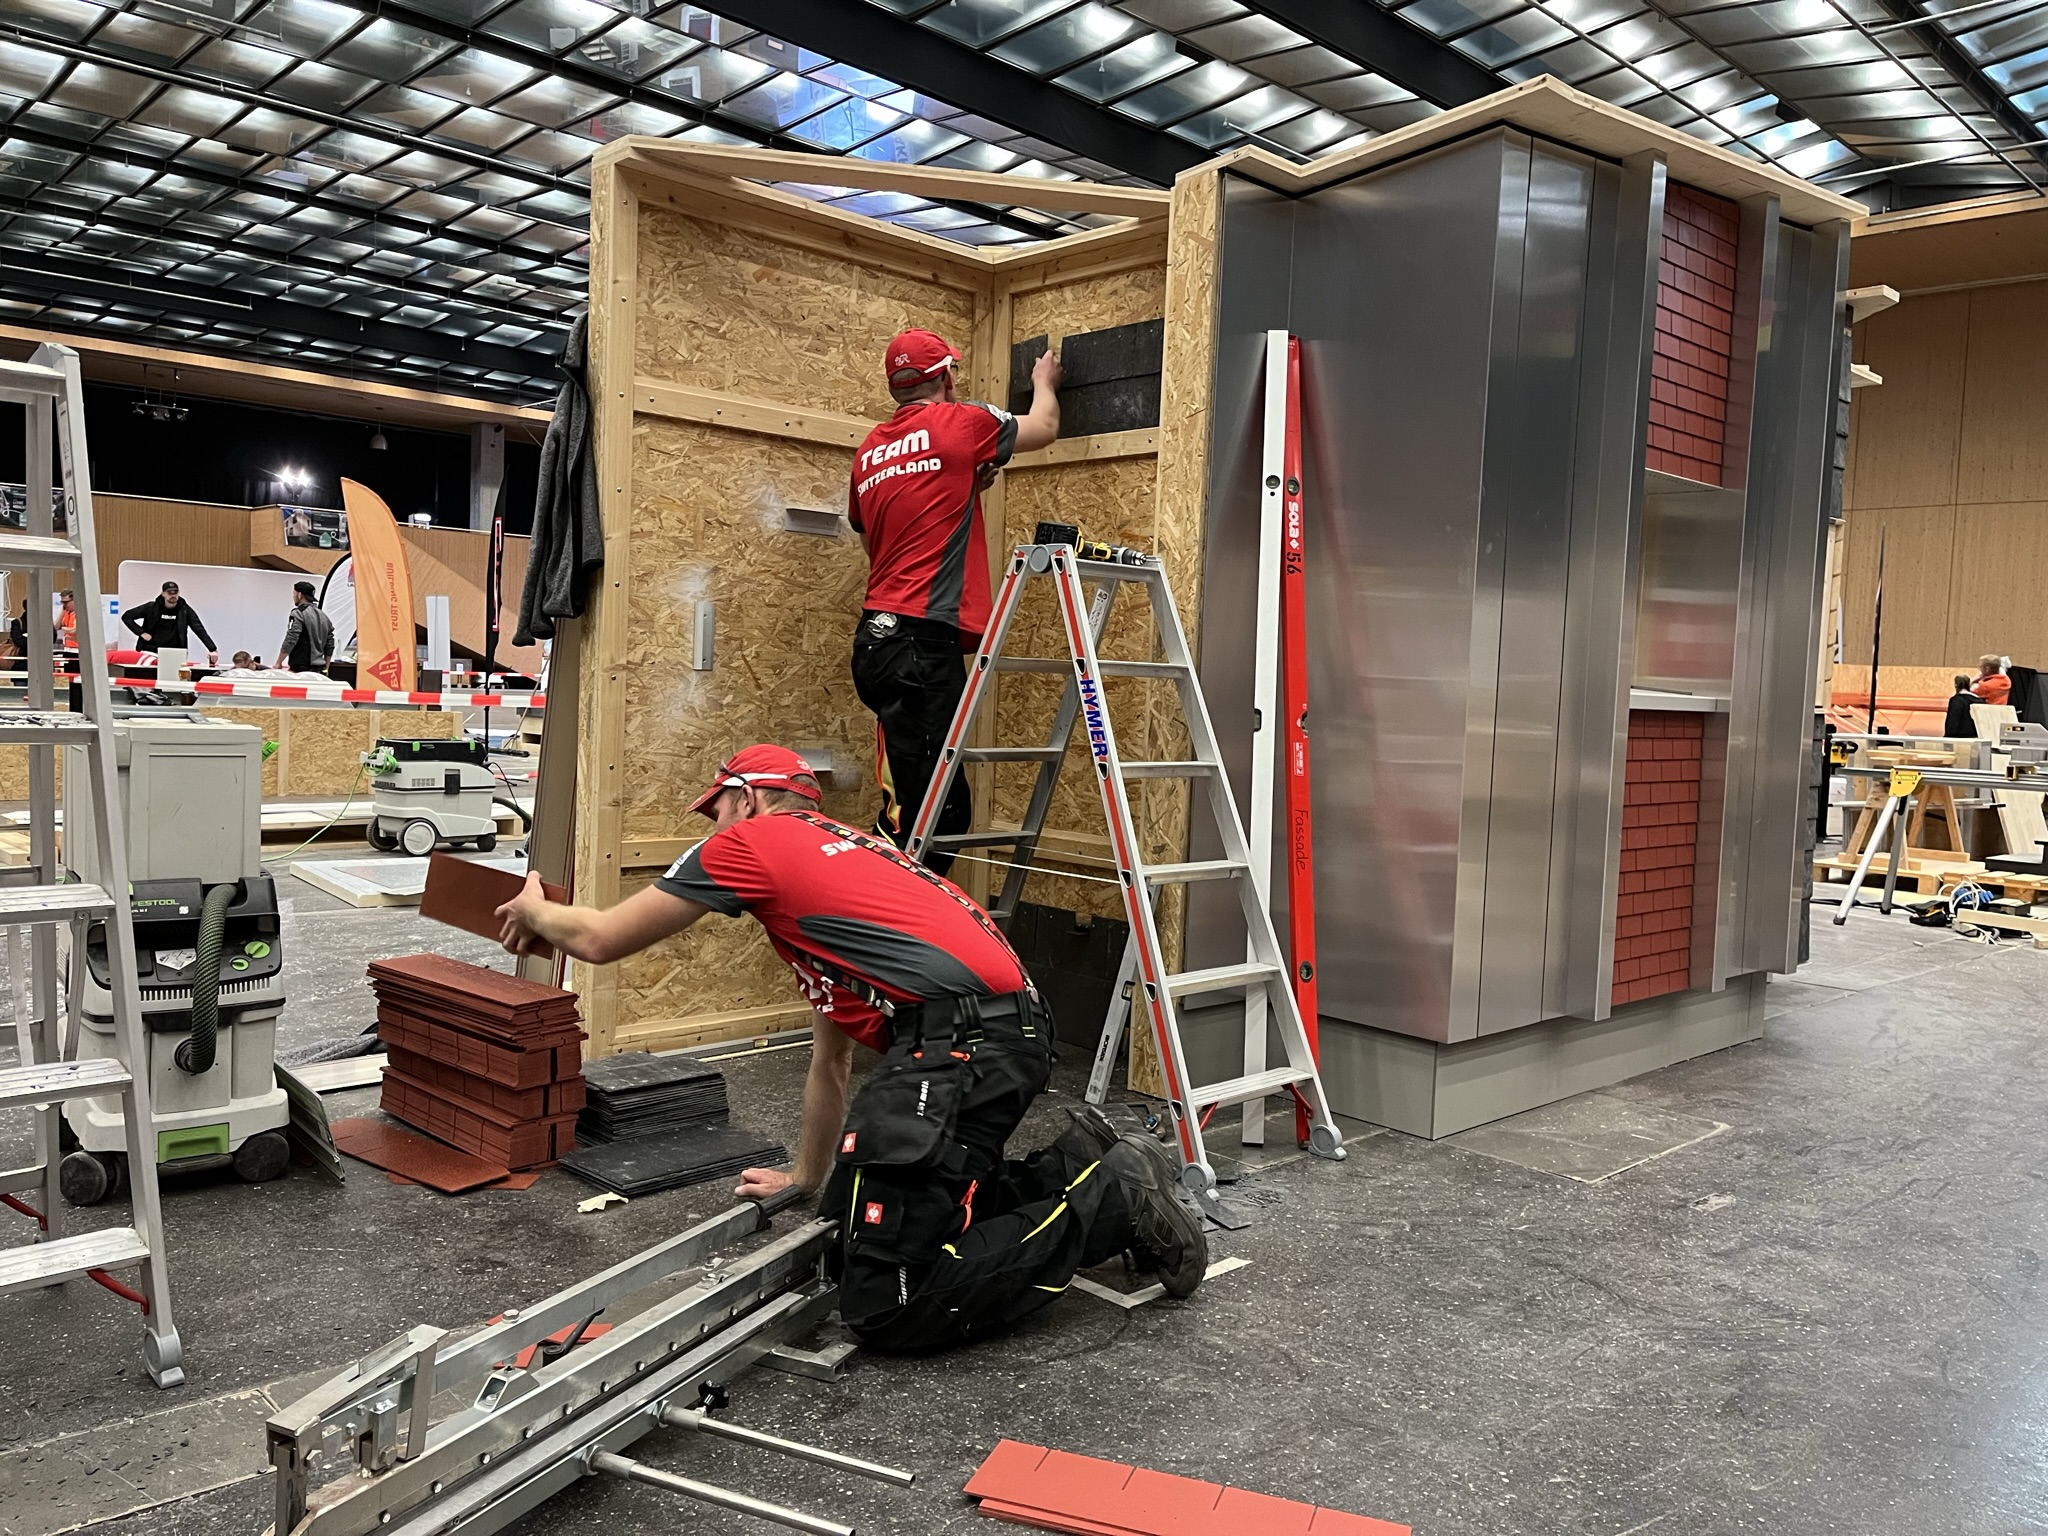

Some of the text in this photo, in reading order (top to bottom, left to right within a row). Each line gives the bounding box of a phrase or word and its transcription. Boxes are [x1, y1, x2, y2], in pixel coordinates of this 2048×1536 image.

[861, 429, 930, 473] TEAM
[857, 458, 942, 498] SWITZERLAND
[1079, 679, 1109, 757] HYMER
[1294, 809, 1310, 876] Fassade
[131, 899, 179, 907] FESTOOL
